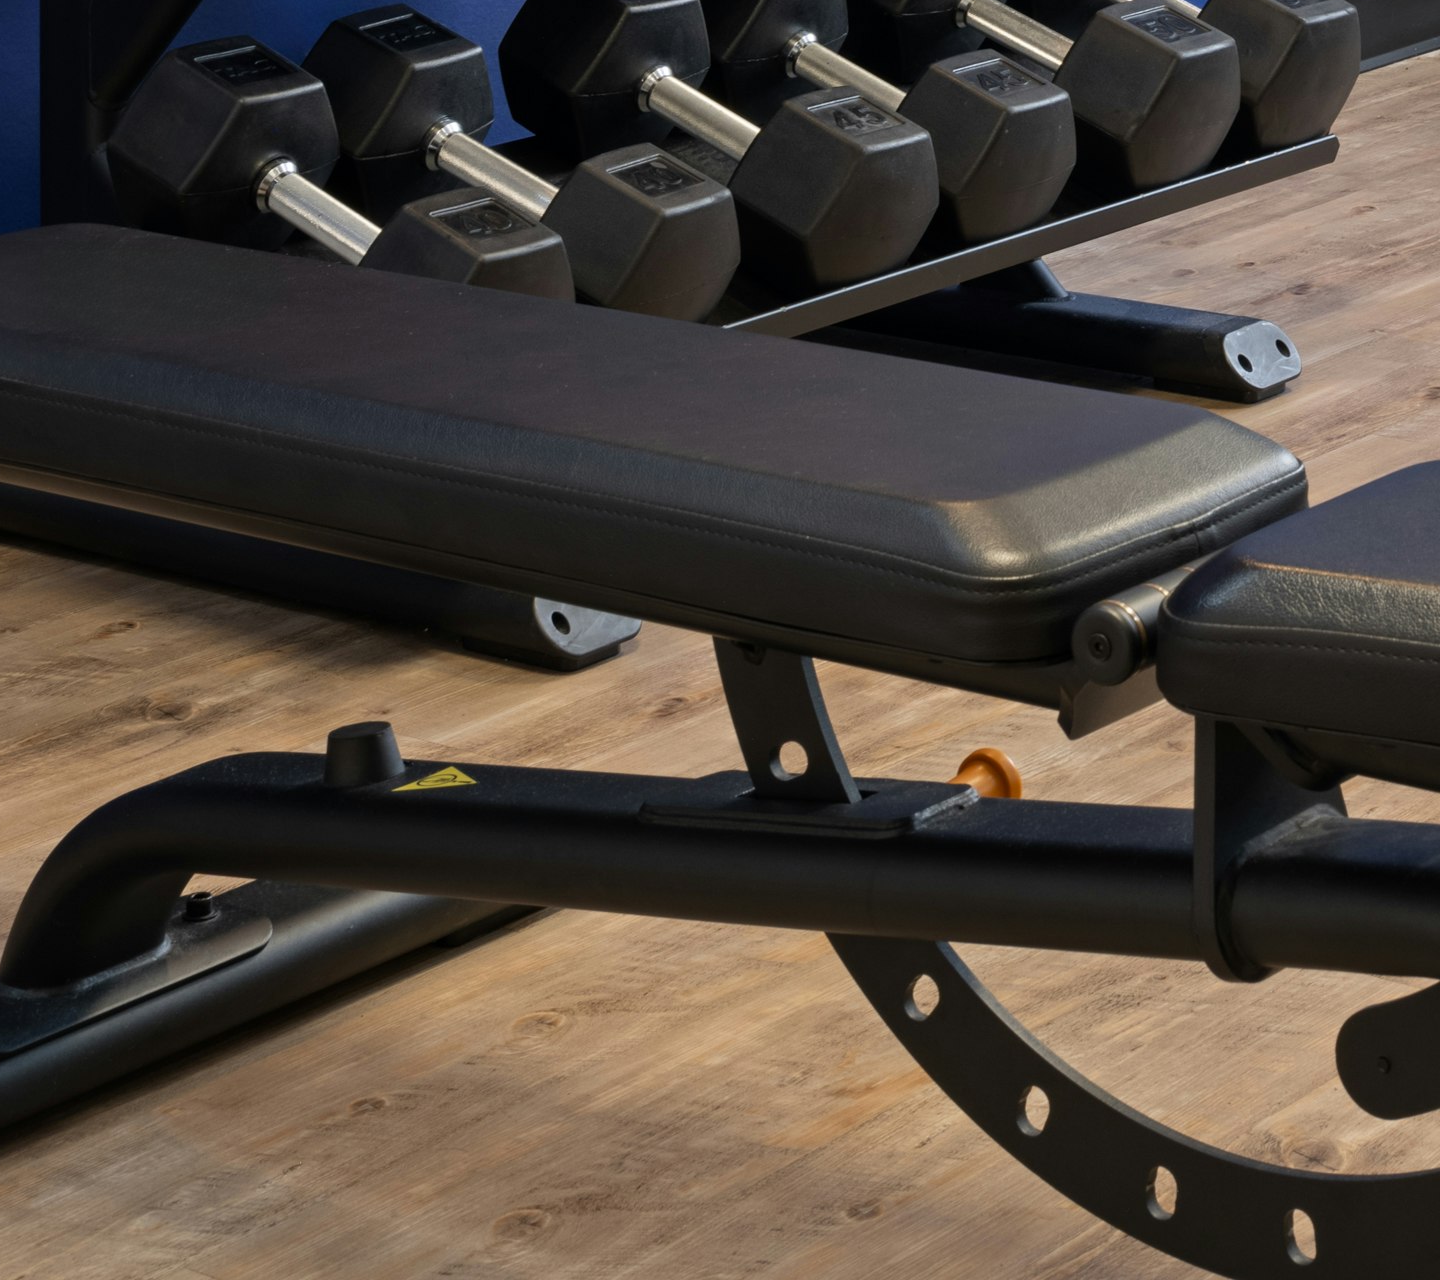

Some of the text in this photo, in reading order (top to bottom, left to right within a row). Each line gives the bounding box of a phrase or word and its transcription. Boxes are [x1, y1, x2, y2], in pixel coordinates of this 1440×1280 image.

[1144, 13, 1197, 41] 50
[976, 68, 1031, 92] 45
[832, 105, 889, 131] 45
[633, 161, 684, 192] 40
[458, 206, 513, 235] 40
